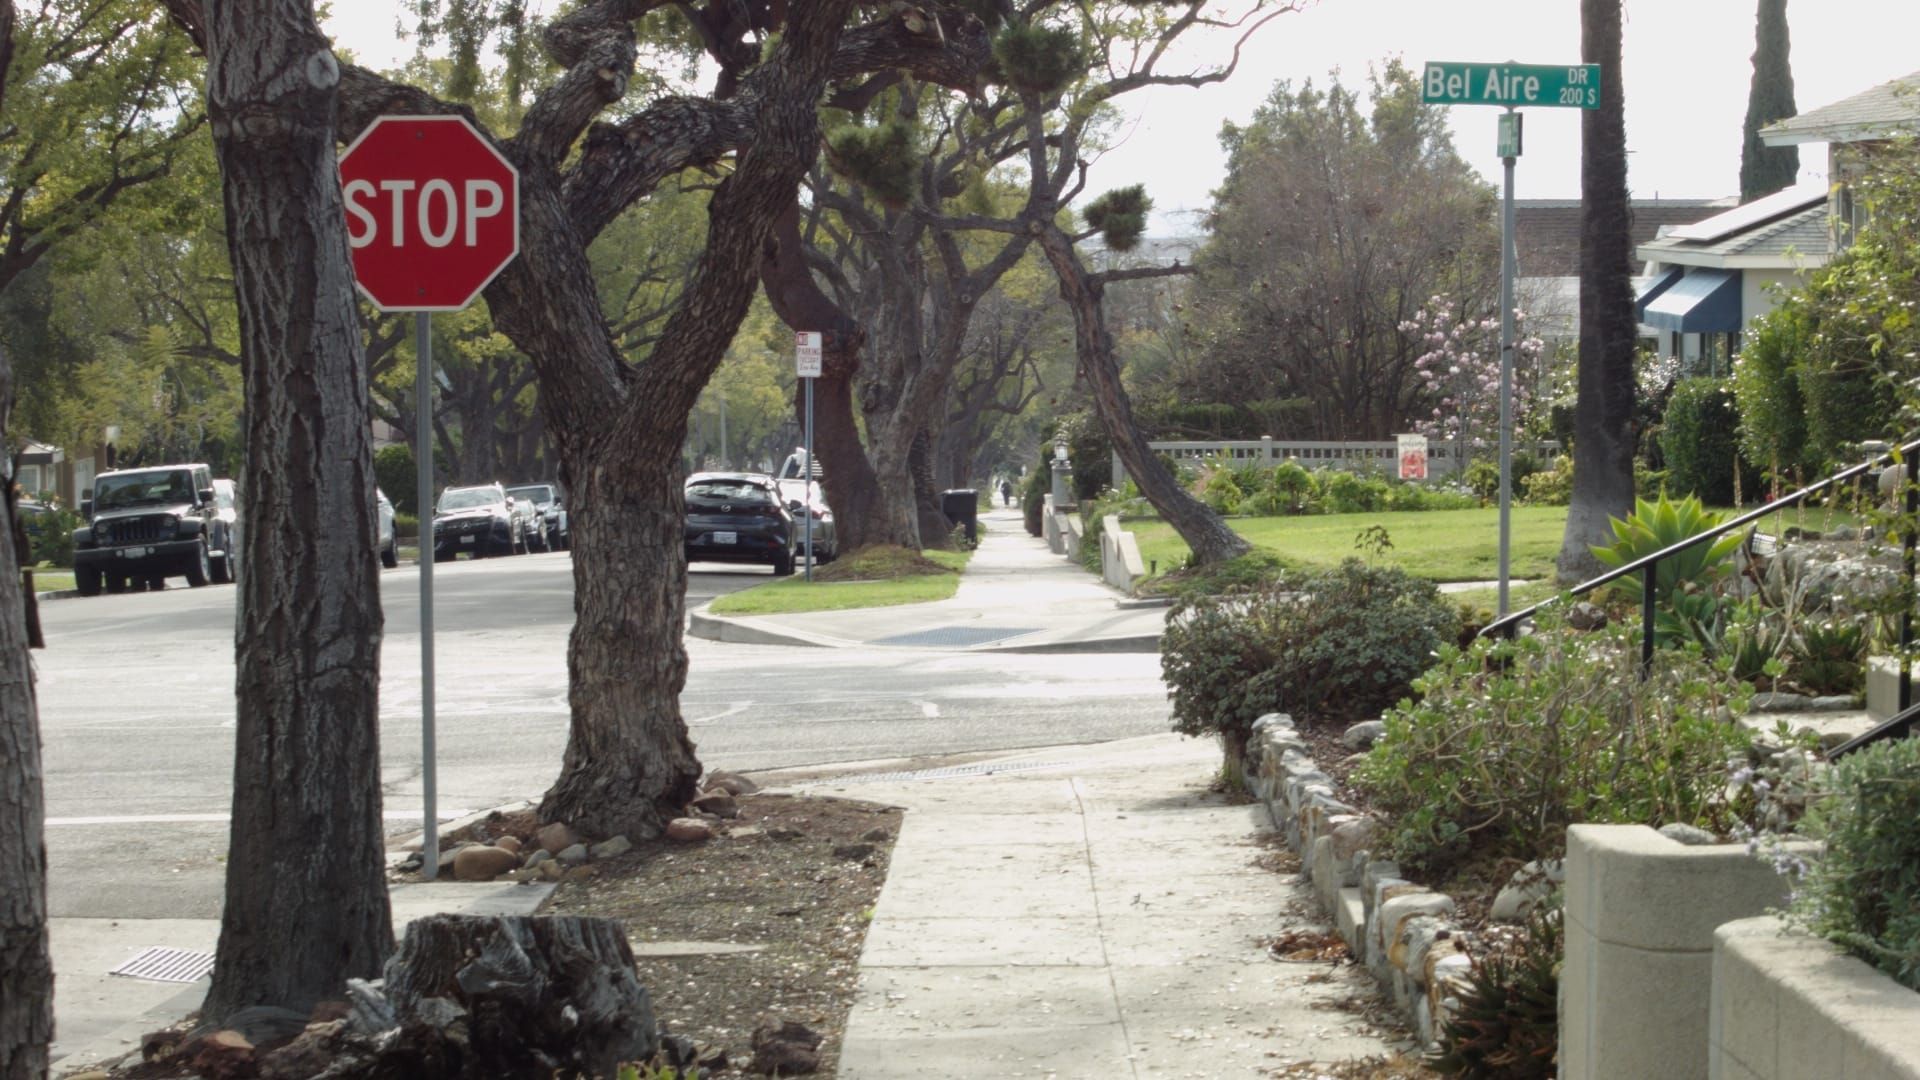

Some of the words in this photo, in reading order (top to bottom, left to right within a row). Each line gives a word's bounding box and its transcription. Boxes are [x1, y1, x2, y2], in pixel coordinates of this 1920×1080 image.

[1426, 66, 1470, 98] Bel
[1482, 68, 1540, 101] Aire
[1568, 68, 1588, 84] DR
[1559, 88, 1583, 104] 200
[1587, 89, 1596, 105] S
[343, 178, 504, 248] STOP
